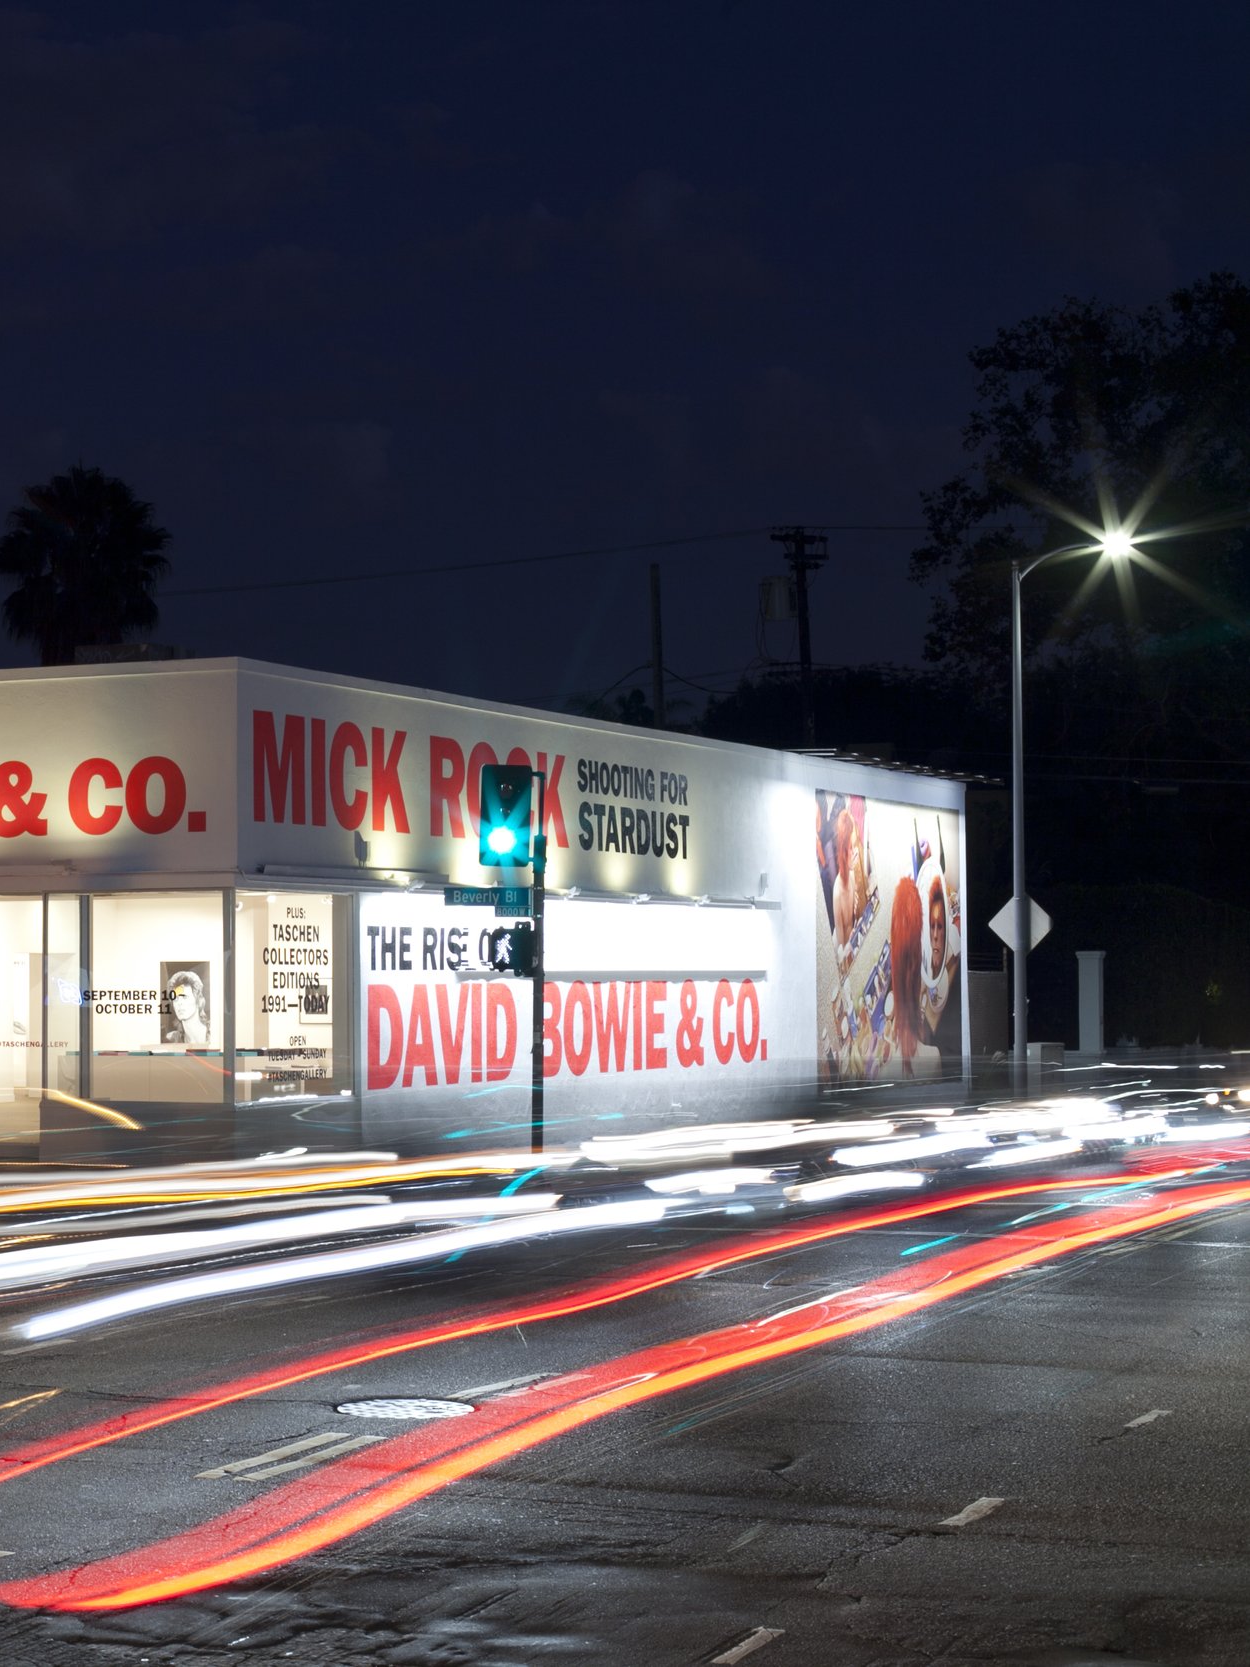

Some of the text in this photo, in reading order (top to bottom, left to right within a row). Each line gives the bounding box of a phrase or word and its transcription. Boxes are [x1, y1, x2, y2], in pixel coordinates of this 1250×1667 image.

[252, 709, 570, 848] MICK ROK
[577, 758, 688, 806] SHOOTING FOR
[68, 756, 207, 835] CO.
[578, 801, 690, 860] STARDUST
[453, 890, 517, 906] Beverly Bl
[286, 907, 306, 919] PLUS:
[273, 924, 320, 943] TASCHEN
[263, 947, 329, 966] COLLECTORS
[367, 926, 412, 970] THE
[272, 971, 320, 990] EDITIONS
[83, 990, 157, 1001] SEPTEMBER
[95, 1004, 172, 1014] OCTOBER 11
[289, 1036, 306, 1046] OPEN
[367, 977, 768, 1090] DAVID BOWIE & CO.
[268, 1050, 295, 1061] TUESDAY
[302, 1048, 327, 1060] SUNDAY
